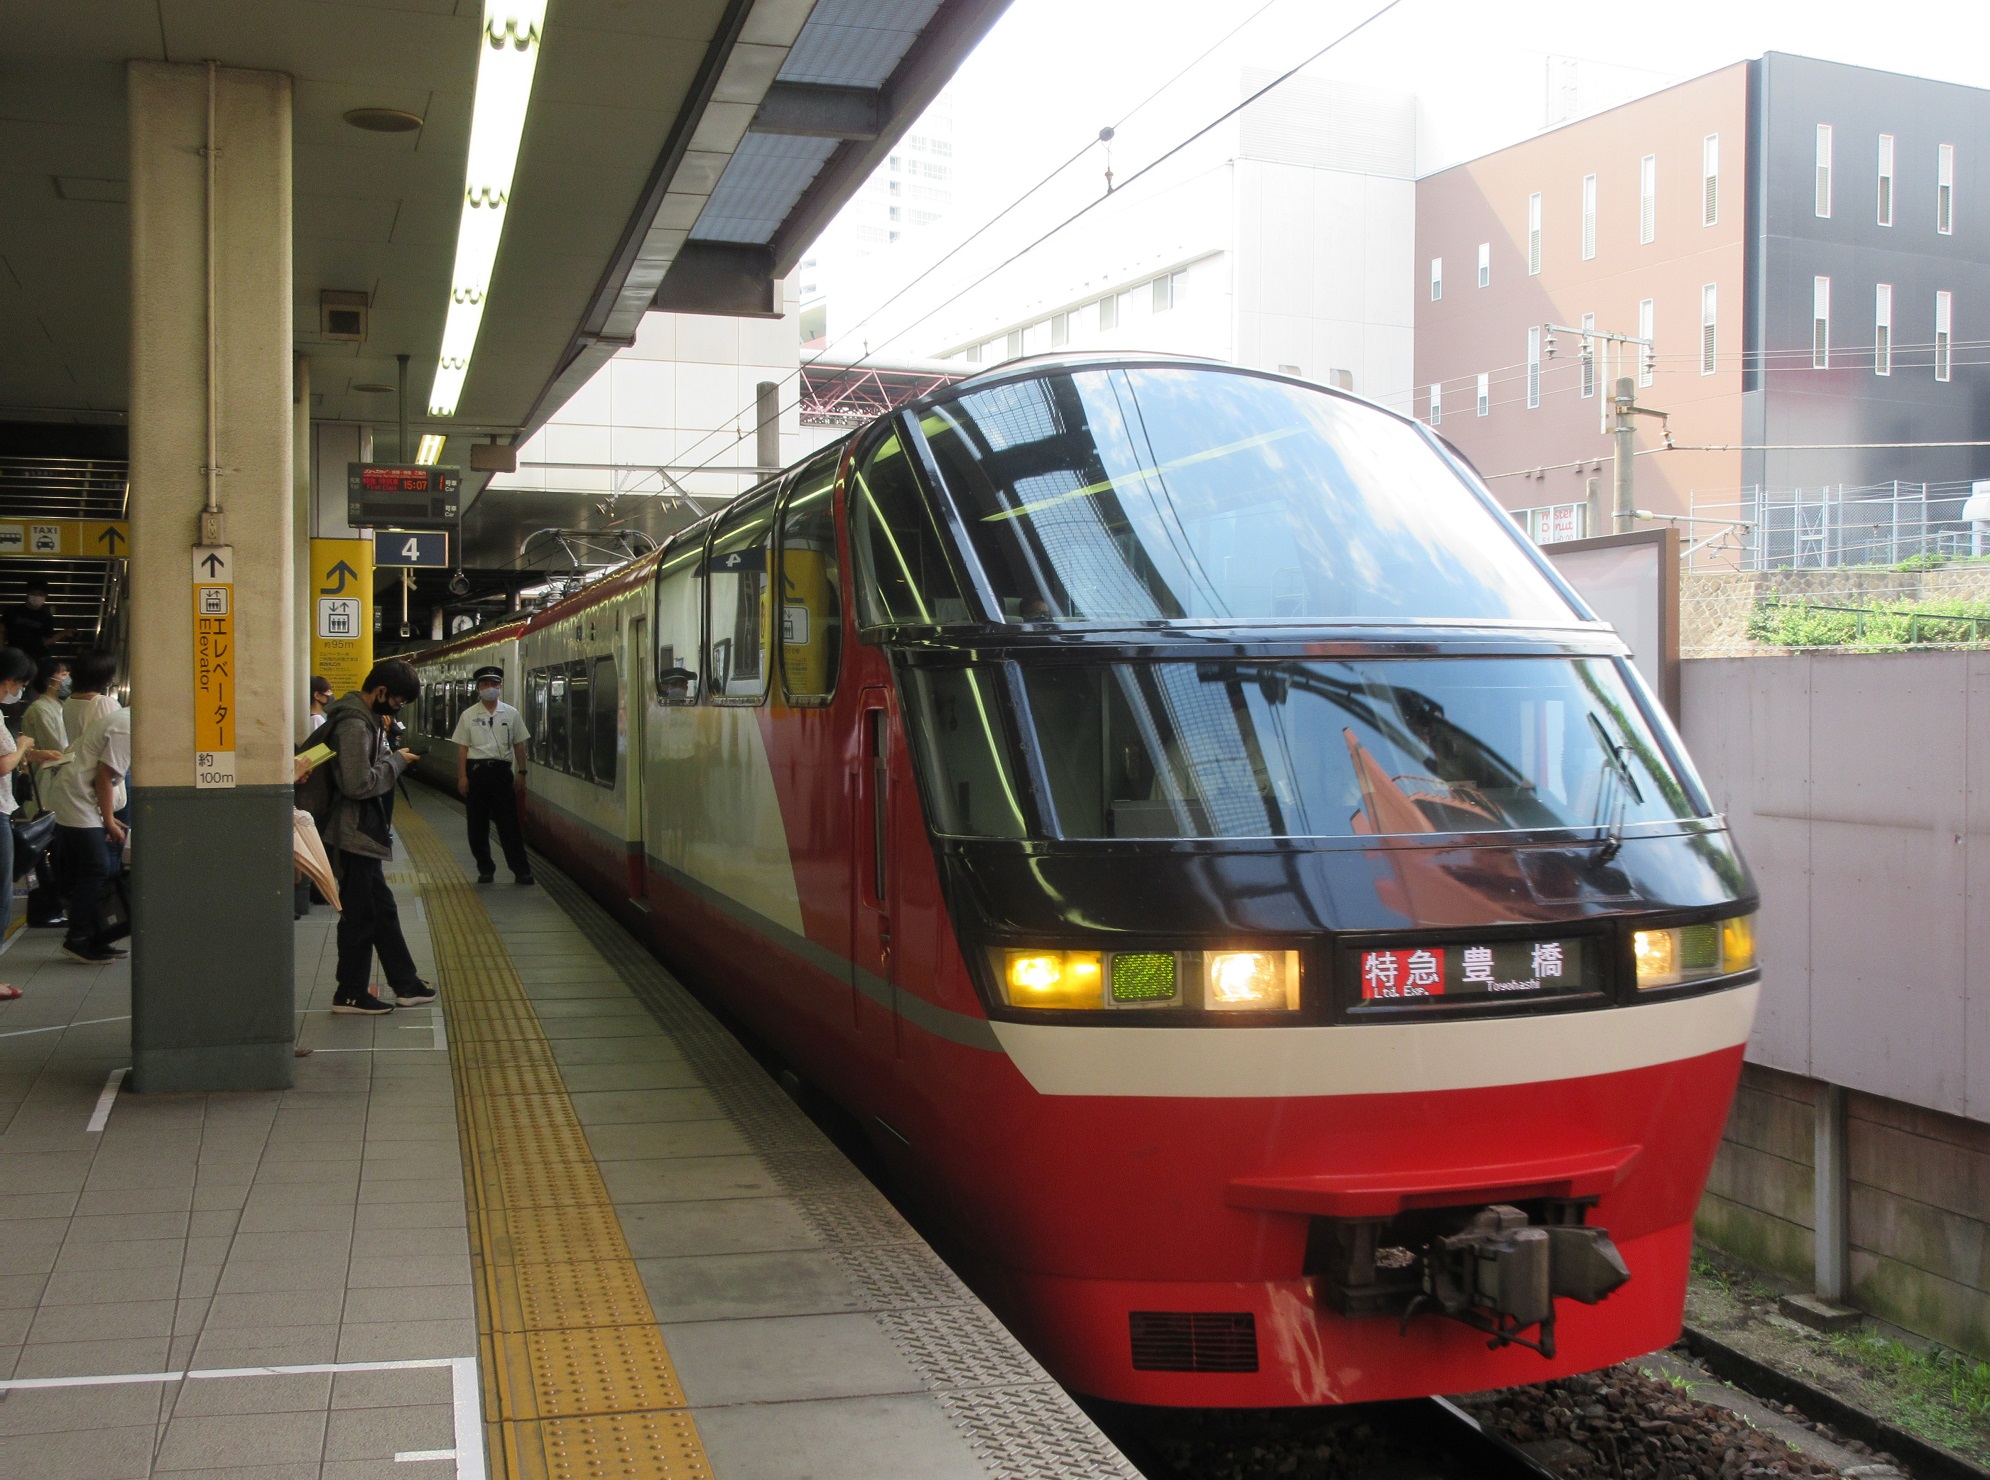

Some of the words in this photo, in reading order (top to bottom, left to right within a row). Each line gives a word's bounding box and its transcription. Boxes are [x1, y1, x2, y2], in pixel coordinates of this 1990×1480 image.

[403, 481, 427, 490] 15:07
[1542, 508, 1573, 521] Mster
[33, 526, 58, 534] TAXI
[1542, 521, 1573, 532] Dnut
[401, 537, 420, 561] 4
[199, 618, 212, 693] Elevator
[212, 618, 229, 746] エレベーター
[198, 752, 214, 767] 約
[199, 771, 234, 784] 100m
[1364, 949, 1439, 987] 特急
[1461, 942, 1564, 982] 豊橋
[1373, 985, 1400, 998] Ltd.
[1403, 985, 1430, 997] Exp.
